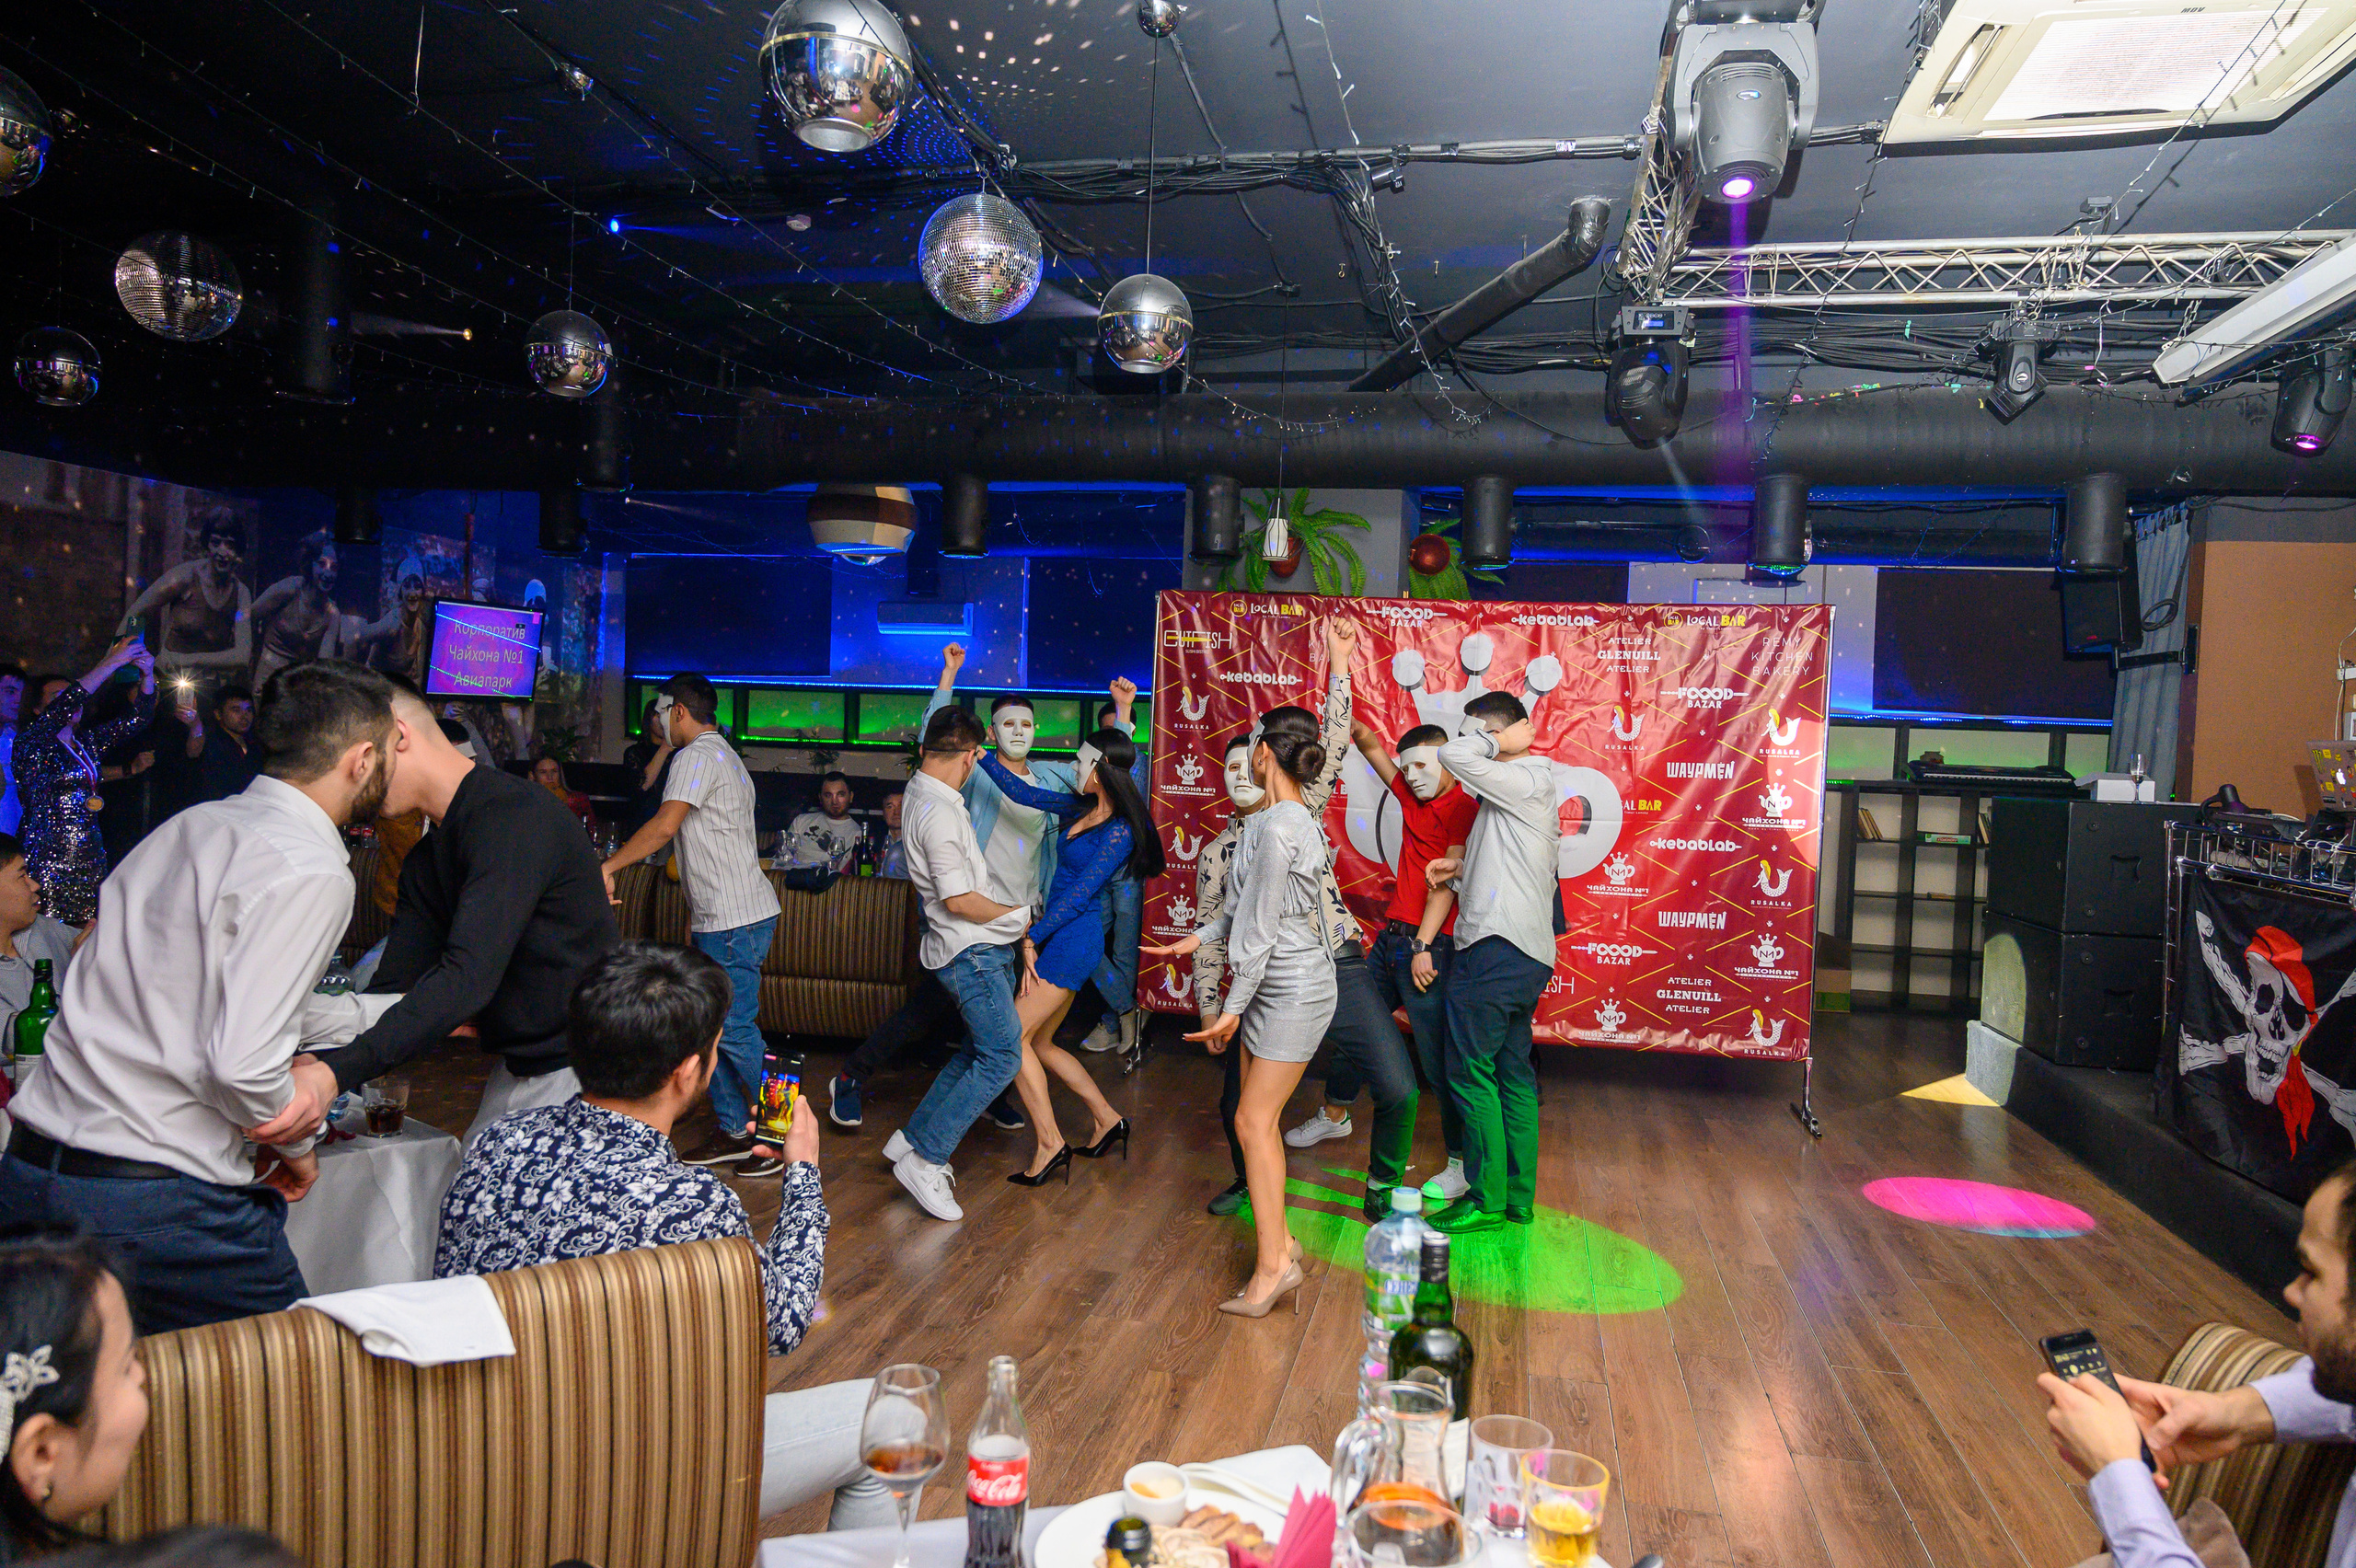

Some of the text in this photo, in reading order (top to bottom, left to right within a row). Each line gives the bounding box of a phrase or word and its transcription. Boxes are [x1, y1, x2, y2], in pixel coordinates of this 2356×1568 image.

[1250, 603, 1303, 616] LOCAL BAR
[1390, 619, 1423, 628] BAZAR
[1686, 614, 1746, 627] LOCAL BAR
[454, 619, 526, 640] Корпоратив
[1608, 637, 1652, 645] ATELIER
[1762, 637, 1801, 647] REMY
[449, 644, 524, 664] Чайхона №1
[1597, 650, 1661, 661] GLENUILL
[1751, 651, 1813, 662] KITCHEN
[1606, 665, 1650, 674] ATELIER
[1752, 666, 1810, 676] BAKERY
[454, 671, 513, 691] Авиапарк
[1687, 699, 1722, 709] BAZAR
[1173, 722, 1210, 731] RUSALKA
[1759, 748, 1800, 756] RUSALKA
[1160, 783, 1202, 792] ЧАЙХОНА
[1638, 799, 1662, 812] BAR
[1741, 816, 1790, 825] ЧАЙХОНА
[1587, 884, 1634, 893] ЧАЙХОНА
[1750, 899, 1792, 907] RUSALKA
[1597, 955, 1631, 965] BAZAR
[1734, 966, 1783, 974] ЧАЙХОНА
[1667, 976, 1712, 986] ATELIER
[1657, 989, 1722, 1002] GLENUILL
[1665, 1004, 1710, 1014] ATELIER
[1744, 1048, 1786, 1057] RUSALKA
